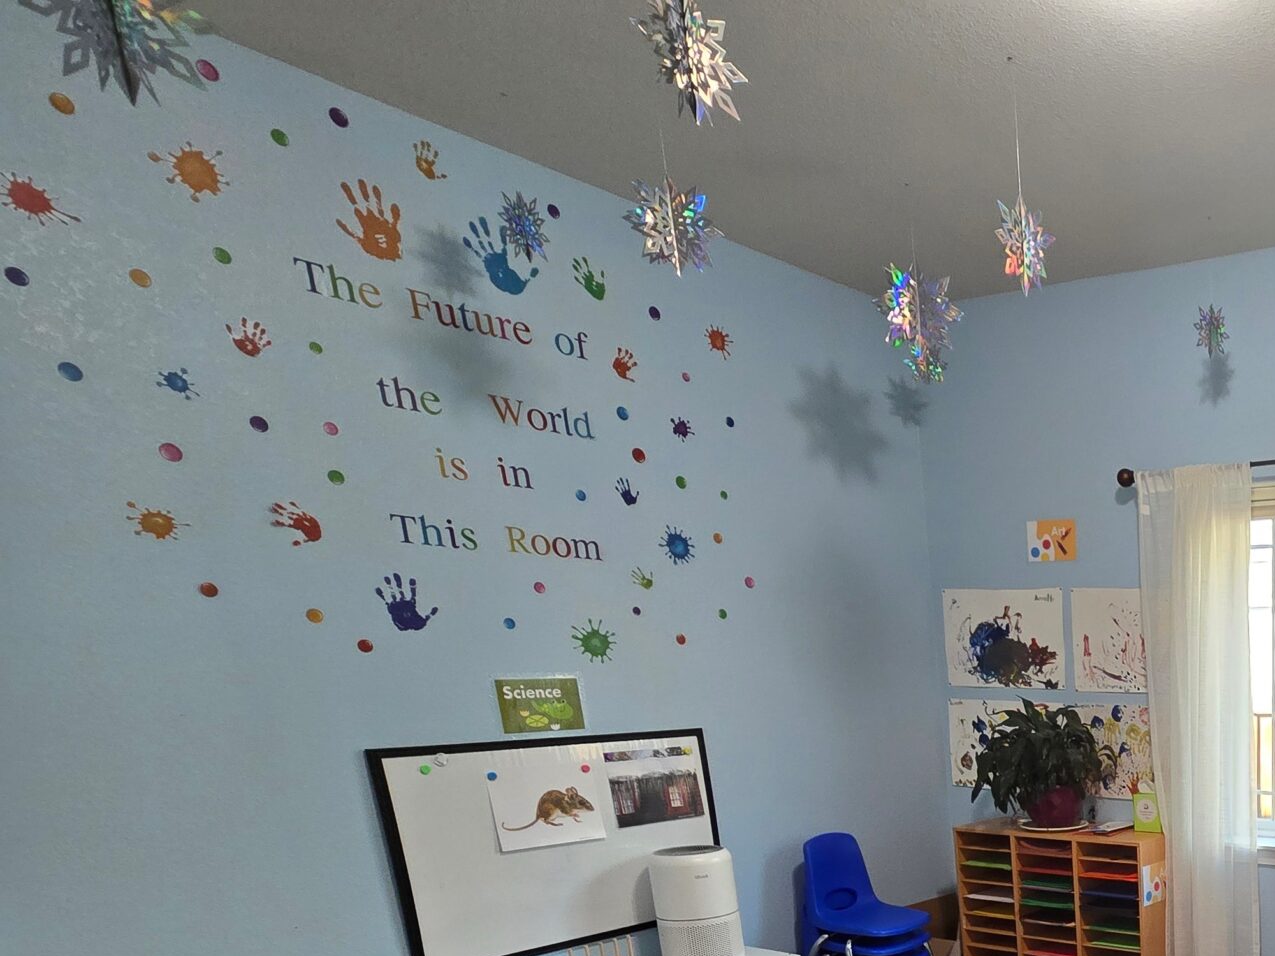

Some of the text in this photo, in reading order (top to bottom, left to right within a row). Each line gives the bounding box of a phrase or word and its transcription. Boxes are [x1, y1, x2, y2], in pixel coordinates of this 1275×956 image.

[293, 256, 590, 360] The Future of
[375, 376, 596, 441] the World
[434, 447, 535, 490] is in
[389, 512, 604, 562] This Room
[502, 684, 562, 699] Science
